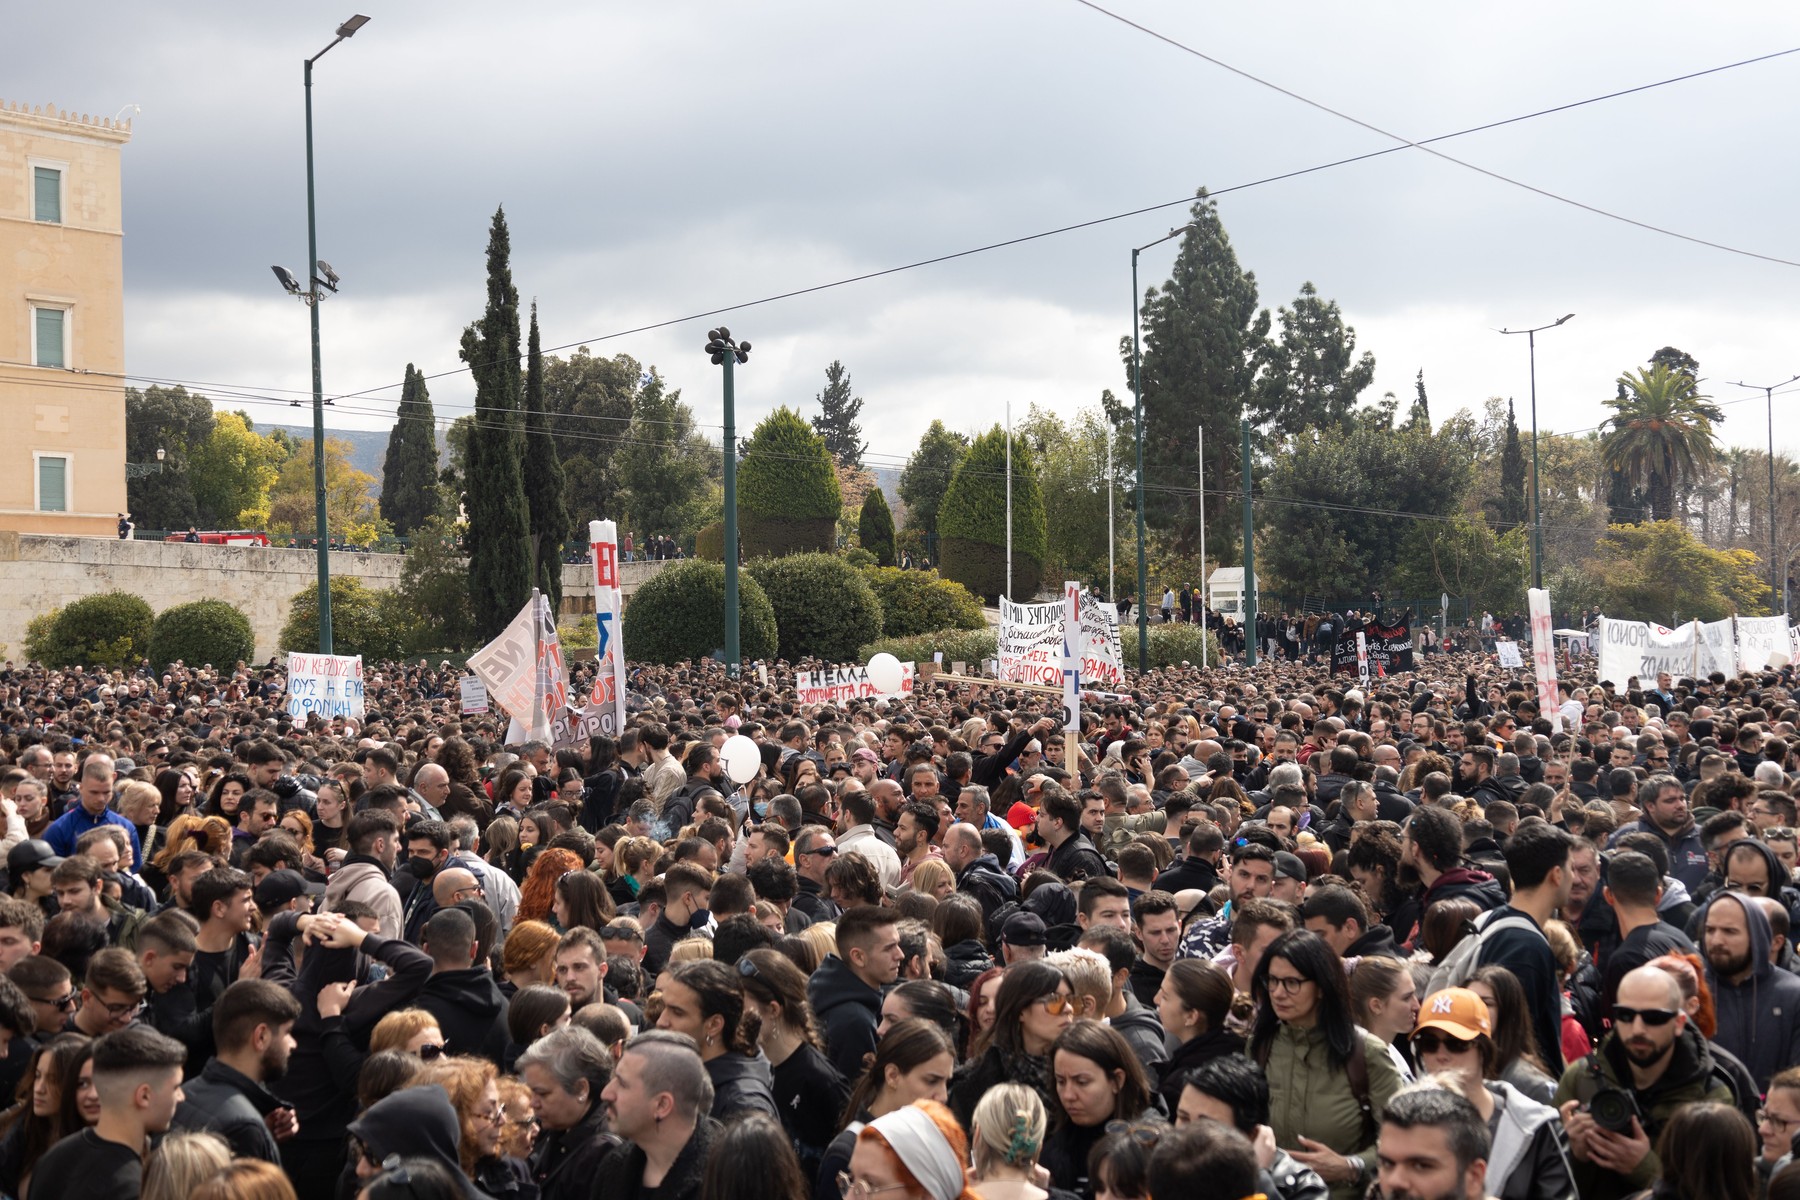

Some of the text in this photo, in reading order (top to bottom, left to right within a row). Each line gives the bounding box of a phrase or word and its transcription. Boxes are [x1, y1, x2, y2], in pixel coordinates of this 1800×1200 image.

[824, 667, 869, 686] ΕΛΛΑ
[327, 681, 335, 697] Η
[345, 680, 364, 698] ΕΥΘ
[1431, 994, 1453, 1014] NY
